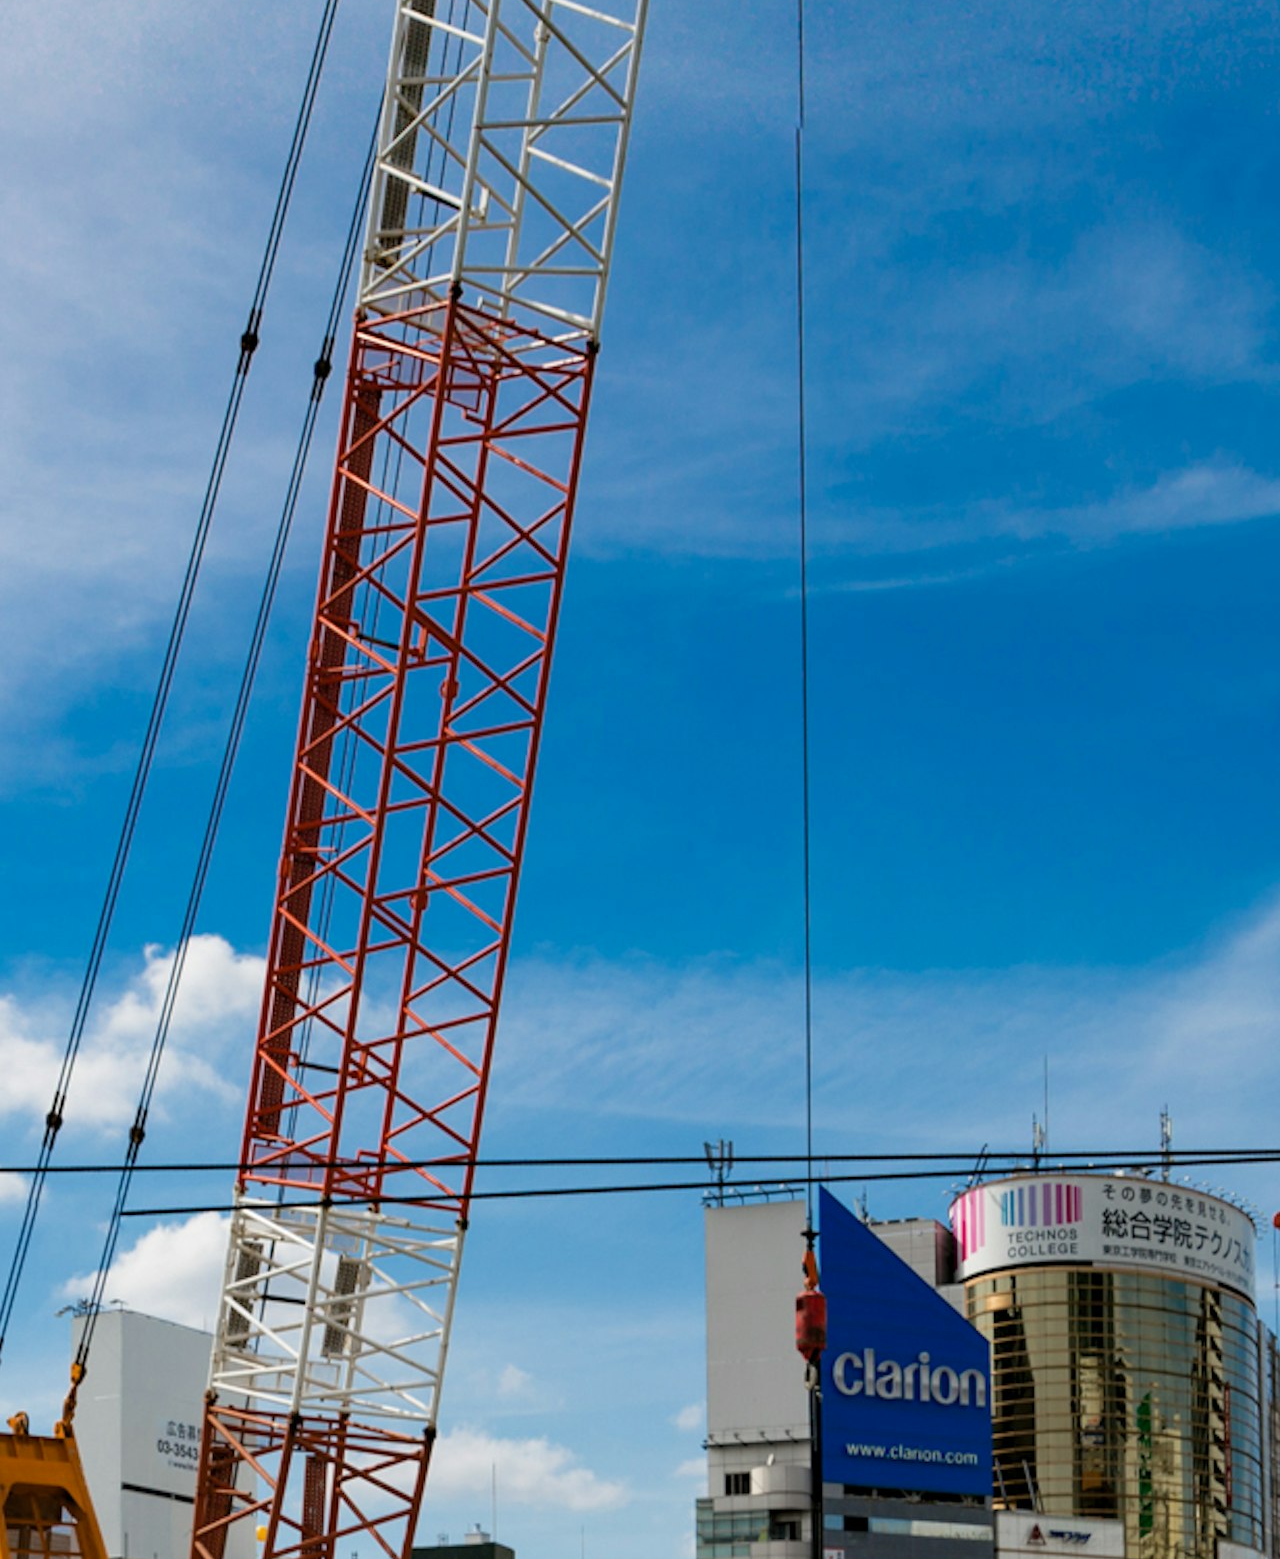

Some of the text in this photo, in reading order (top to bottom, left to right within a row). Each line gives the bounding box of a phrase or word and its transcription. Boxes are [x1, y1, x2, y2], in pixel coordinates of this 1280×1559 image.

[1008, 1229, 1077, 1244] TECHNOS
[1008, 1243, 1078, 1258] COLLEGE
[832, 1347, 987, 1408] Clarion
[846, 1443, 978, 1466] www.clarion.com
